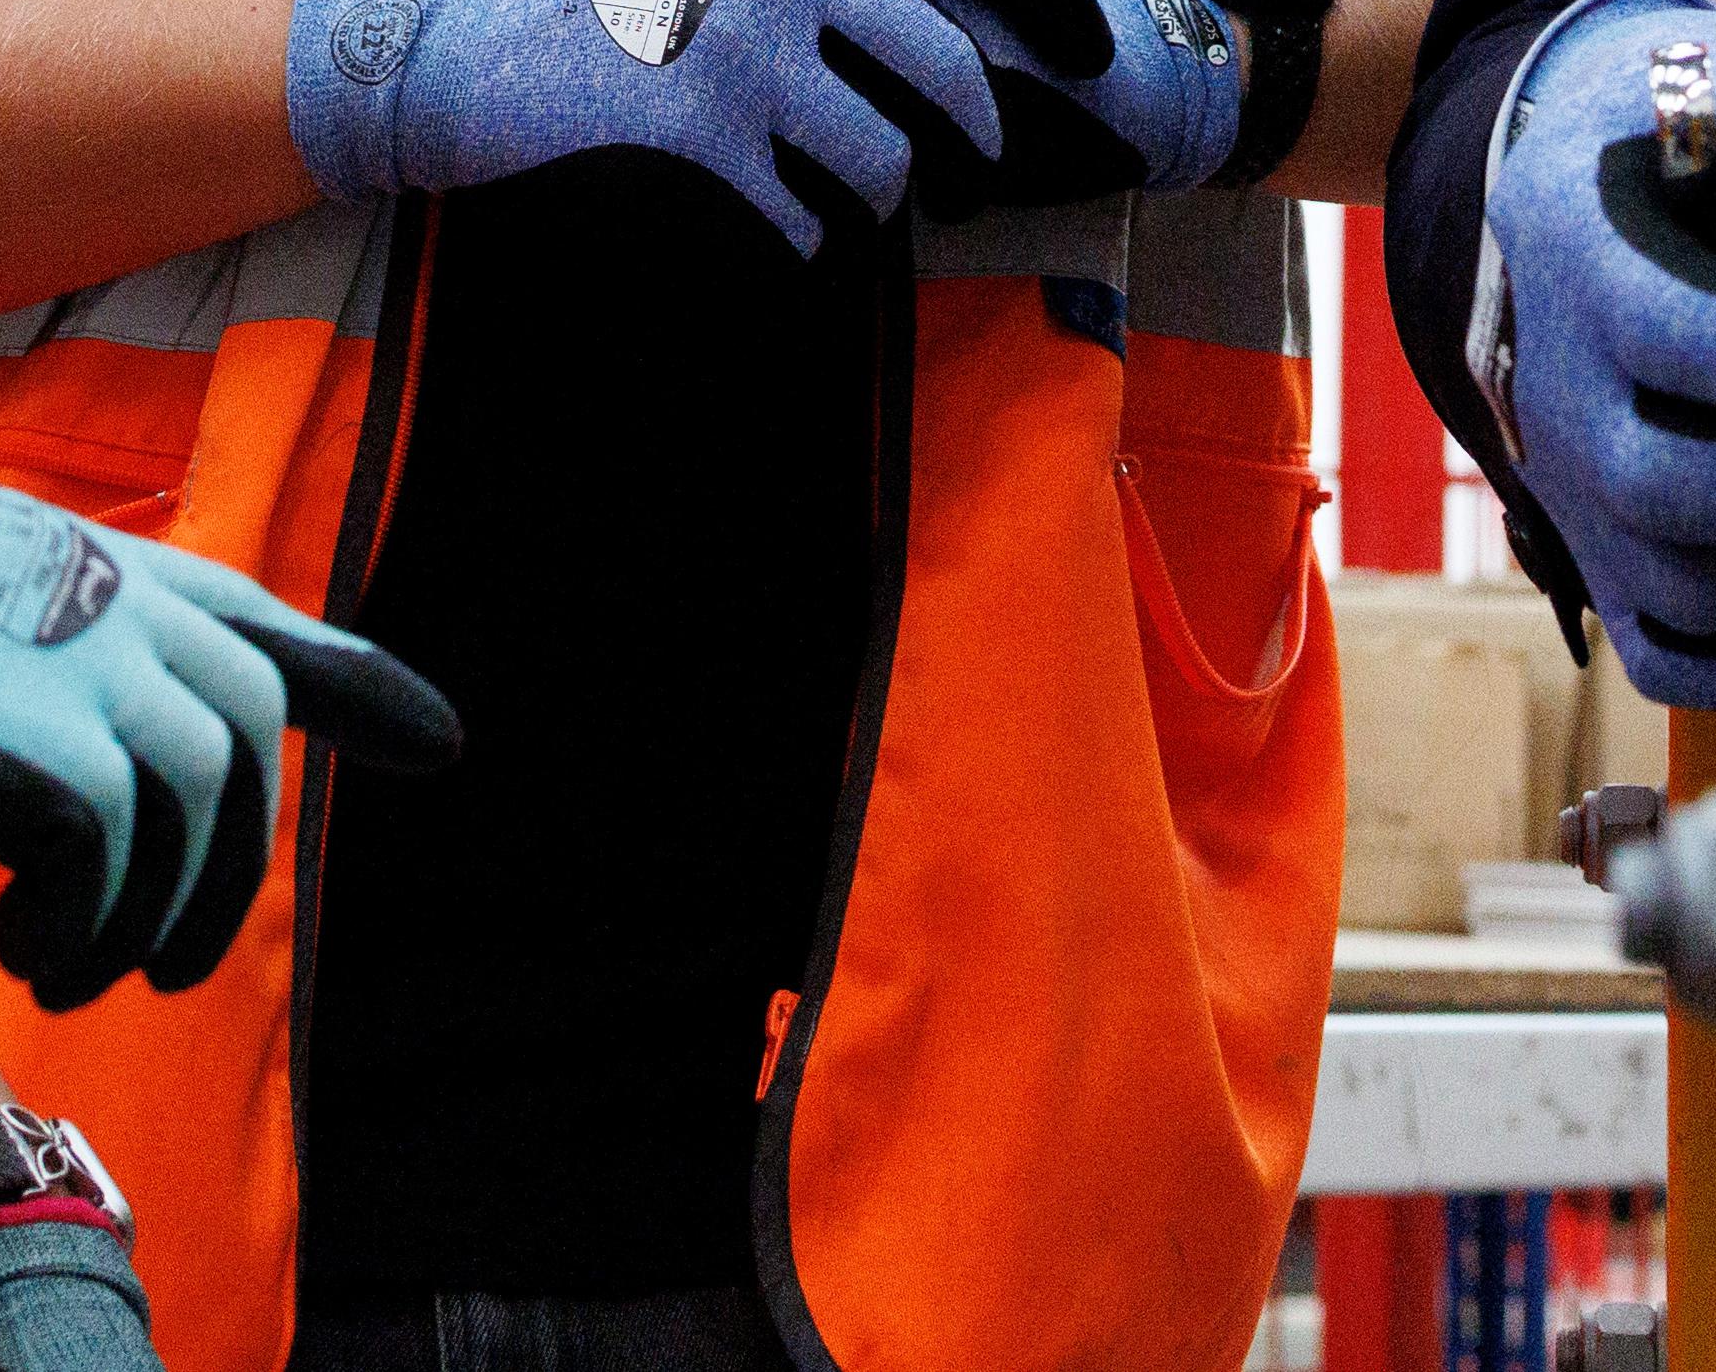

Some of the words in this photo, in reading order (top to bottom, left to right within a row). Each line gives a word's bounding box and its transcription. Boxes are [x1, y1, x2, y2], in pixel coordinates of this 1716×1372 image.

[610, 10, 623, 26] 10
[634, 13, 646, 33] PEN
[656, 15, 669, 27] N
[667, 36, 678, 50] UK
